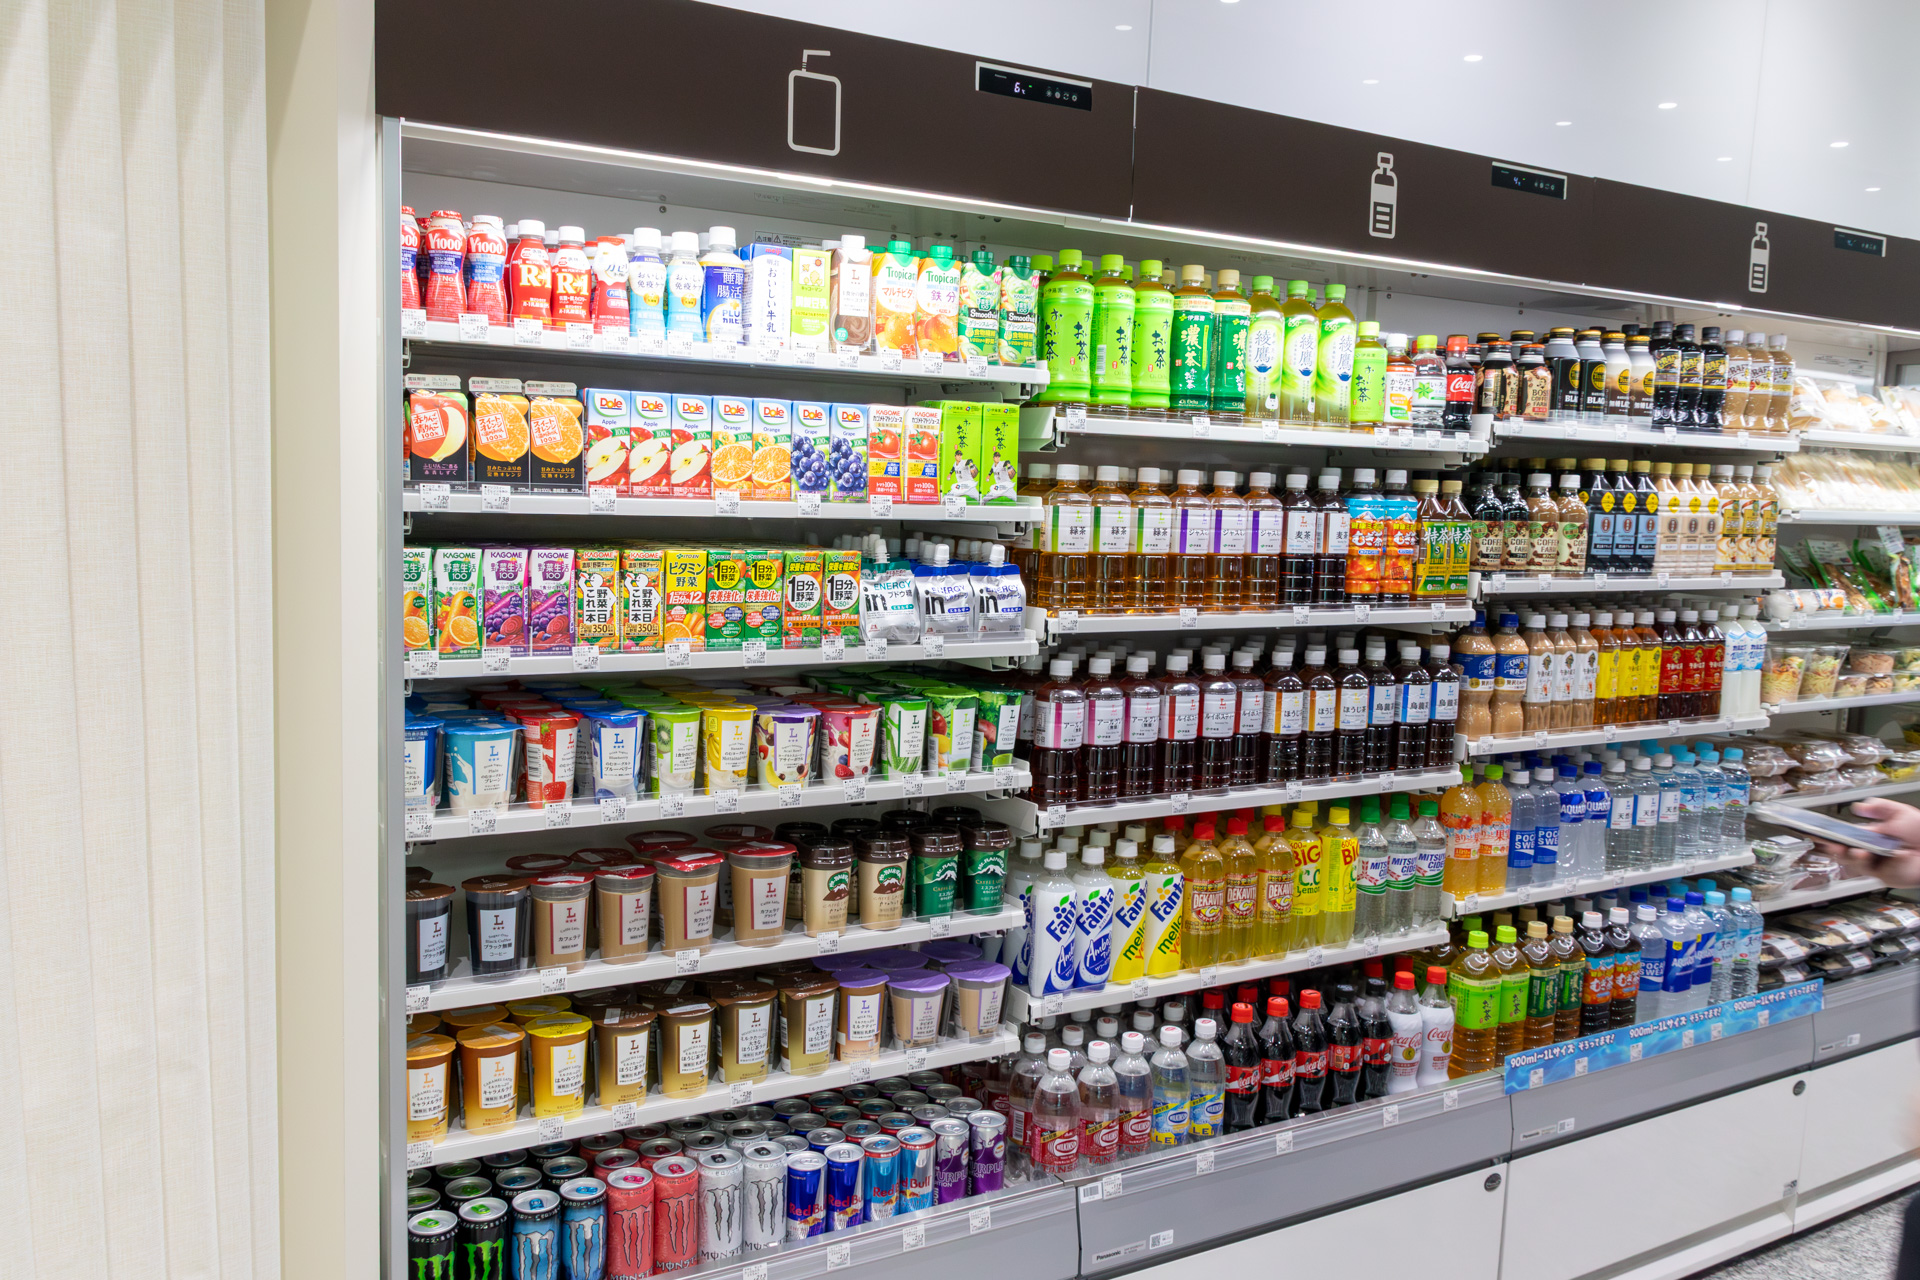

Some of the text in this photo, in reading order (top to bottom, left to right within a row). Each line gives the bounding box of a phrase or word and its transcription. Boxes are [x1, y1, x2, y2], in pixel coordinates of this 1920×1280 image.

[428, 233, 462, 251] Y1000
[468, 237, 504, 254] Y1000
[556, 273, 589, 297] R-1
[766, 267, 777, 333] おいしい牛乳
[930, 290, 956, 302] 鉄分
[1151, 330, 1167, 369] お茶
[1180, 323, 1202, 368] 濃い茶
[1254, 329, 1272, 364] 綾鷹
[1299, 333, 1315, 368] 綾鷹
[600, 397, 623, 408] Dole
[641, 400, 664, 410] Dole
[682, 402, 704, 412] Dole
[723, 404, 745, 415] Dole
[763, 406, 785, 418] Dole
[841, 410, 861, 421] Dole
[1070, 526, 1087, 535] 緑茶
[1111, 526, 1127, 535] 緑茶
[1153, 527, 1168, 536] 緑茶
[1295, 530, 1311, 540] 麦茶
[1424, 527, 1448, 545] 特茶
[1448, 527, 1472, 545] 特茶
[1352, 531, 1383, 547] むぎ茶
[490, 551, 523, 559] KAGOME
[669, 562, 705, 576] ビタミン
[676, 577, 698, 587] 野菜
[874, 581, 911, 591] ENERGY
[796, 591, 815, 602] 野菜
[887, 590, 913, 598] ブドウ糖
[925, 590, 946, 614] in
[979, 588, 999, 613] in
[1219, 698, 1226, 706] L
[1343, 705, 1367, 714] ほうじ茶
[964, 713, 970, 723] L
[685, 726, 694, 738] L
[735, 725, 743, 736] L
[862, 723, 870, 733] L
[614, 733, 624, 744] L
[490, 745, 499, 757] L
[766, 882, 776, 893] L
[700, 890, 709, 901] L
[1149, 874, 1185, 922] Fanta
[635, 898, 644, 909] L
[1239, 899, 1251, 911] C
[566, 908, 577, 919] L
[1075, 888, 1115, 936] Fanta
[1205, 905, 1218, 918] C
[493, 914, 504, 926] L
[433, 921, 442, 933] L
[558, 934, 582, 943] カフェラテ
[483, 942, 513, 950] ブラック無糖
[861, 999, 870, 1010] L
[692, 1029, 701, 1040] L
[630, 1039, 639, 1050] L
[741, 1043, 766, 1053] ほうじ茶ラテ
[567, 1049, 576, 1060] L
[681, 1052, 708, 1062] ほうじ茶ラテ
[494, 1061, 504, 1073] L
[424, 1072, 434, 1084] L
[554, 1073, 583, 1083] はちみつラテ
[482, 1086, 514, 1096] キャラメルラテ
[910, 1175, 932, 1189] Bull
[872, 1186, 894, 1199] Red
[828, 1194, 850, 1207] Red
[789, 1202, 811, 1216] Red
[1096, 1250, 1122, 1261] Panasonic
